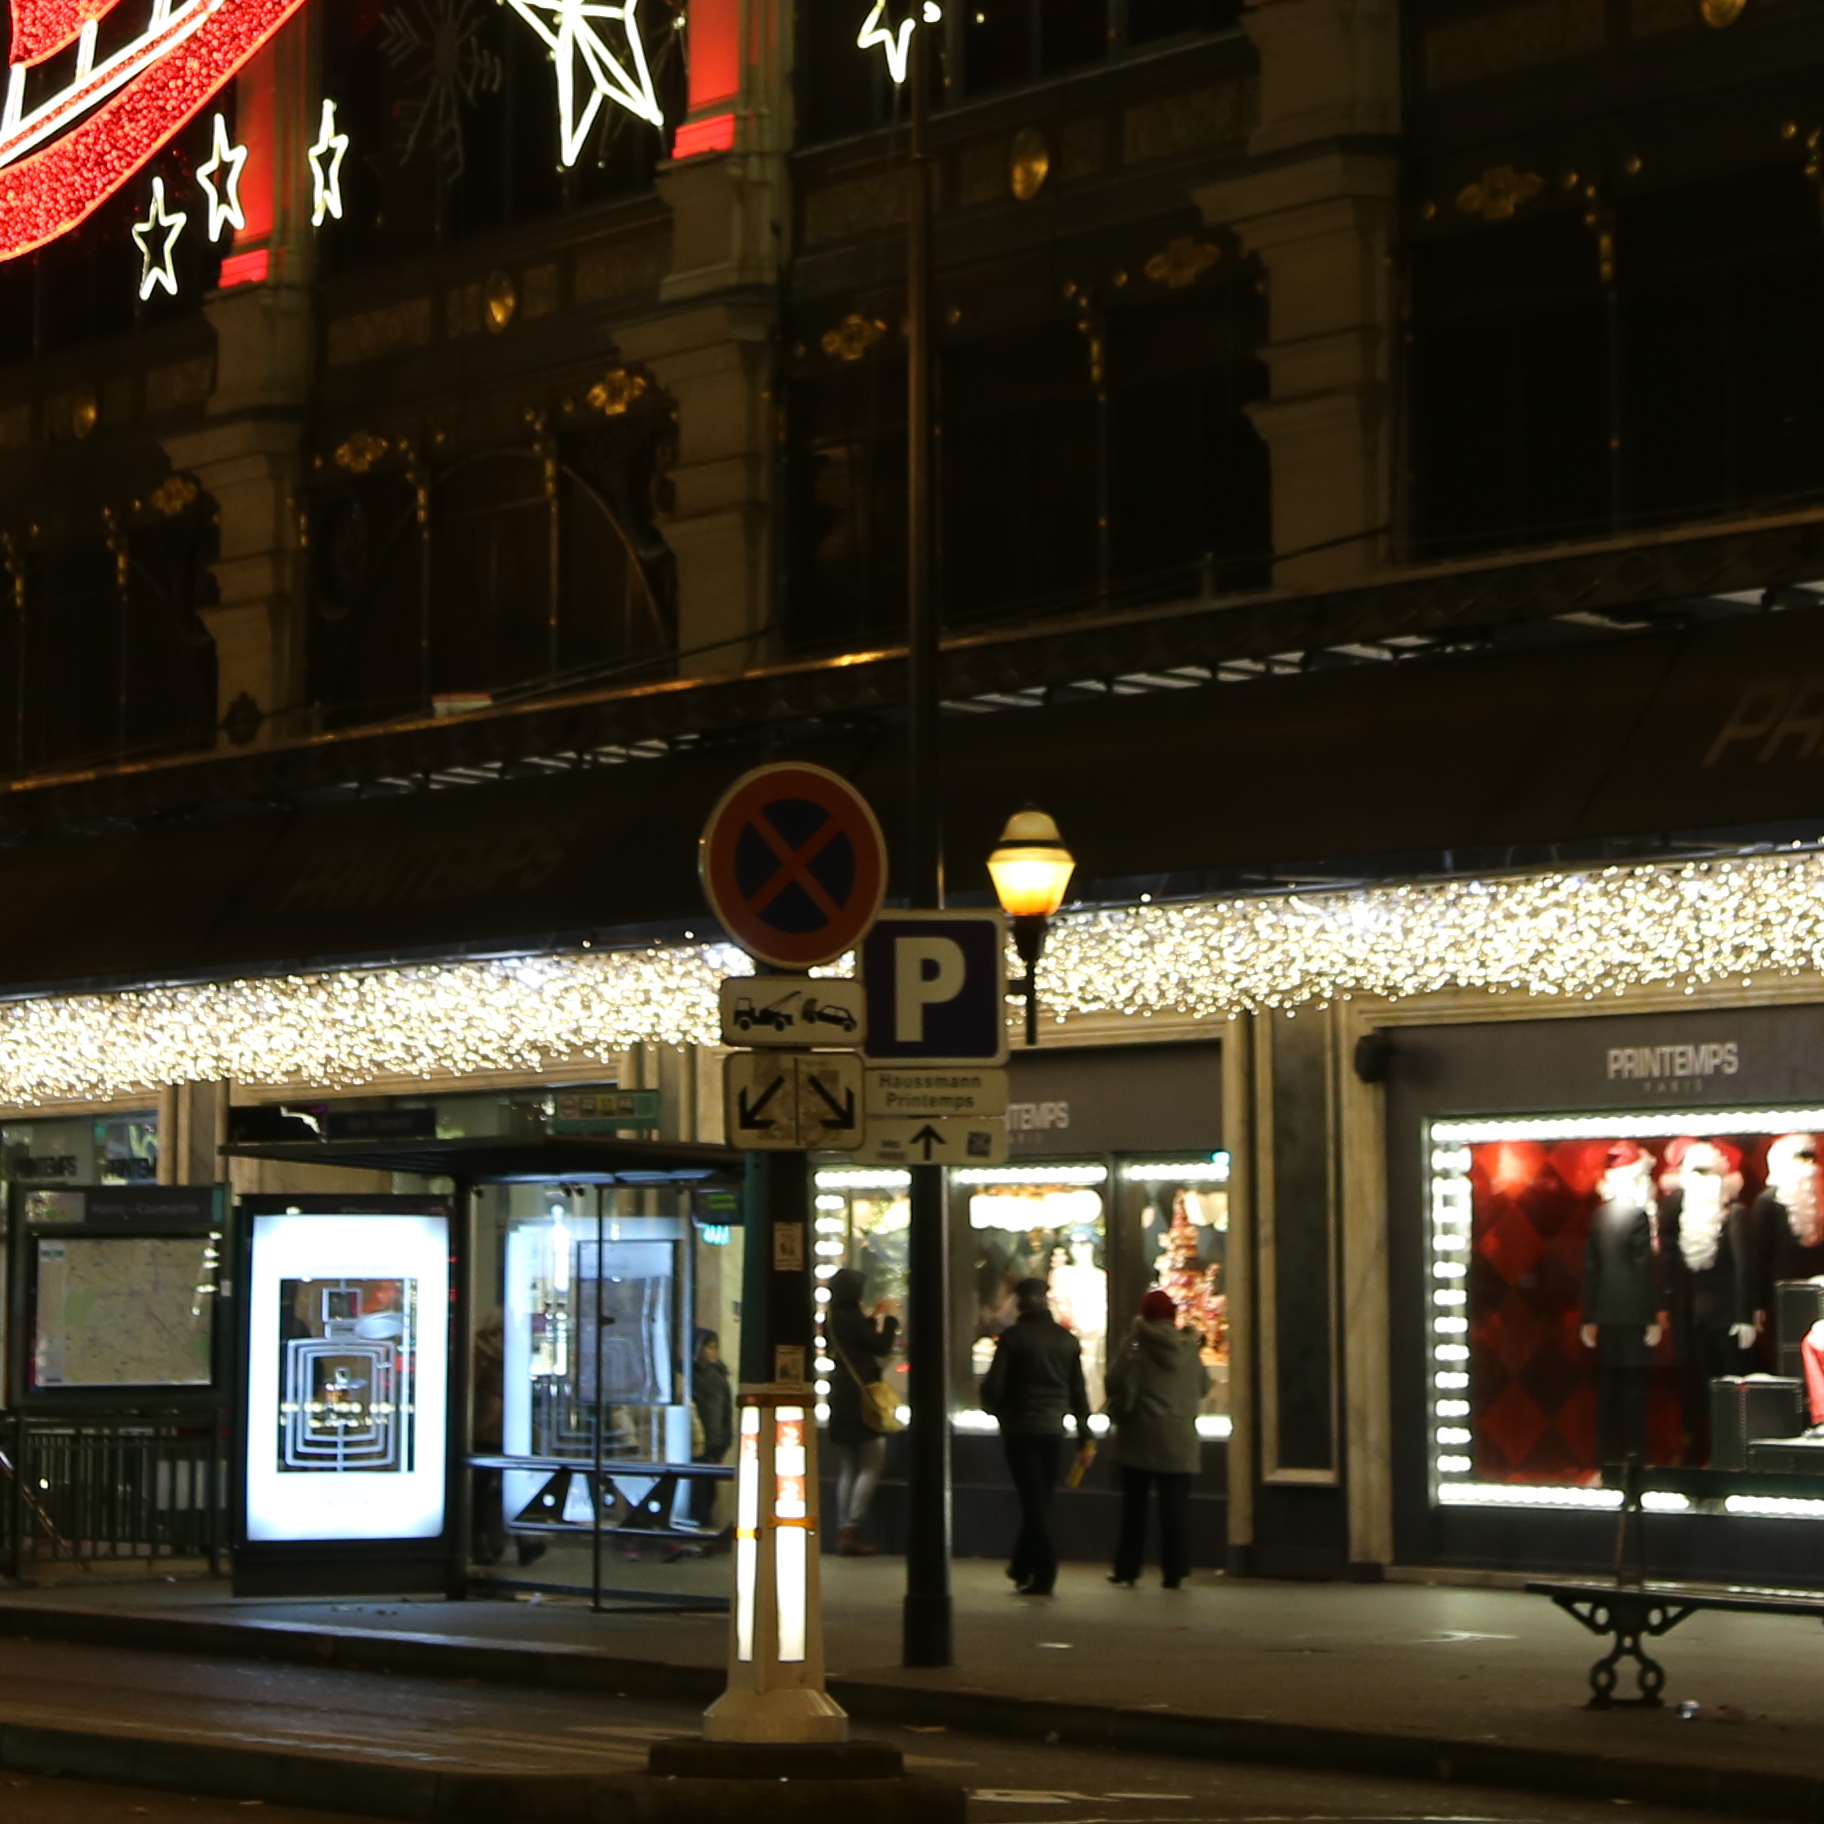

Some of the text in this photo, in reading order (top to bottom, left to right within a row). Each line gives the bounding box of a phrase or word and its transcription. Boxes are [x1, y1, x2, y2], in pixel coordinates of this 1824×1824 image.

[895, 937, 966, 1042] P
[1607, 1041, 1739, 1079] PRINTEMPS
[879, 1075, 982, 1088] Haussmann
[886, 1093, 974, 1109] Printemps
